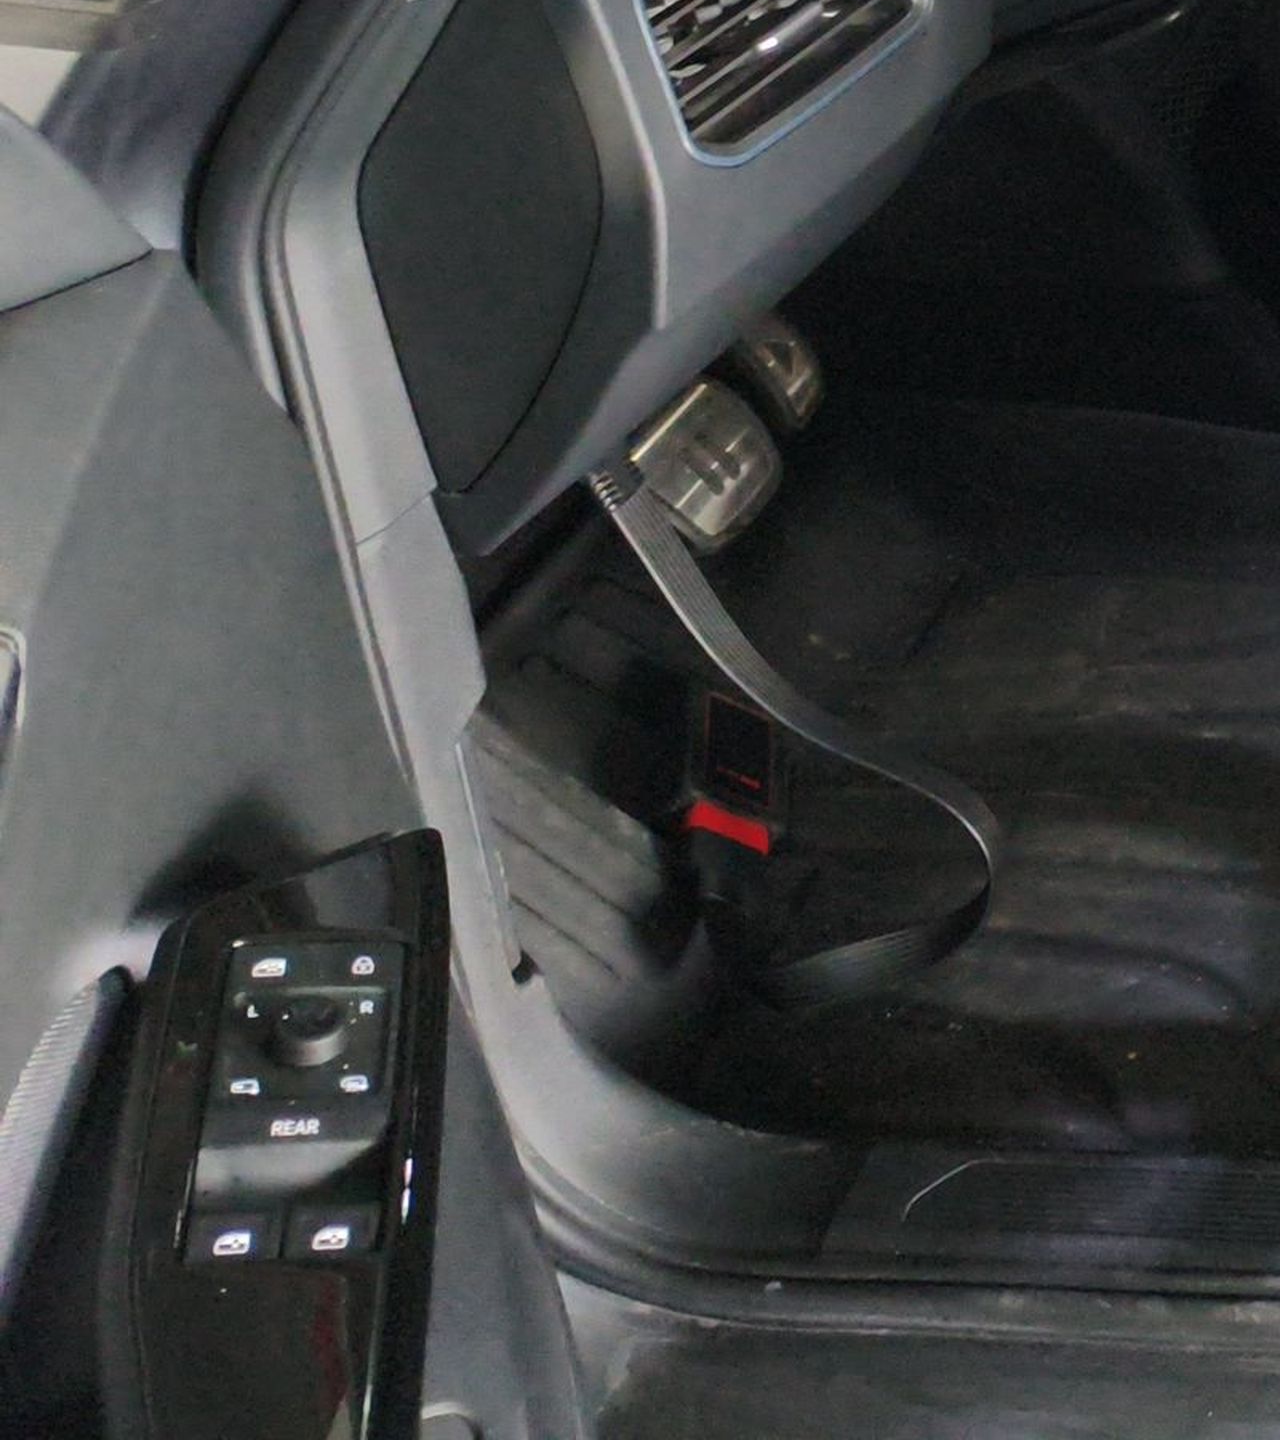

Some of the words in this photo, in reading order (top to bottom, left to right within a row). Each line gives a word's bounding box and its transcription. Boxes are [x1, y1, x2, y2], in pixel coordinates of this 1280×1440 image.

[247, 1005, 259, 1018] L
[360, 1000, 374, 1014] R
[270, 1118, 320, 1137] REAR
